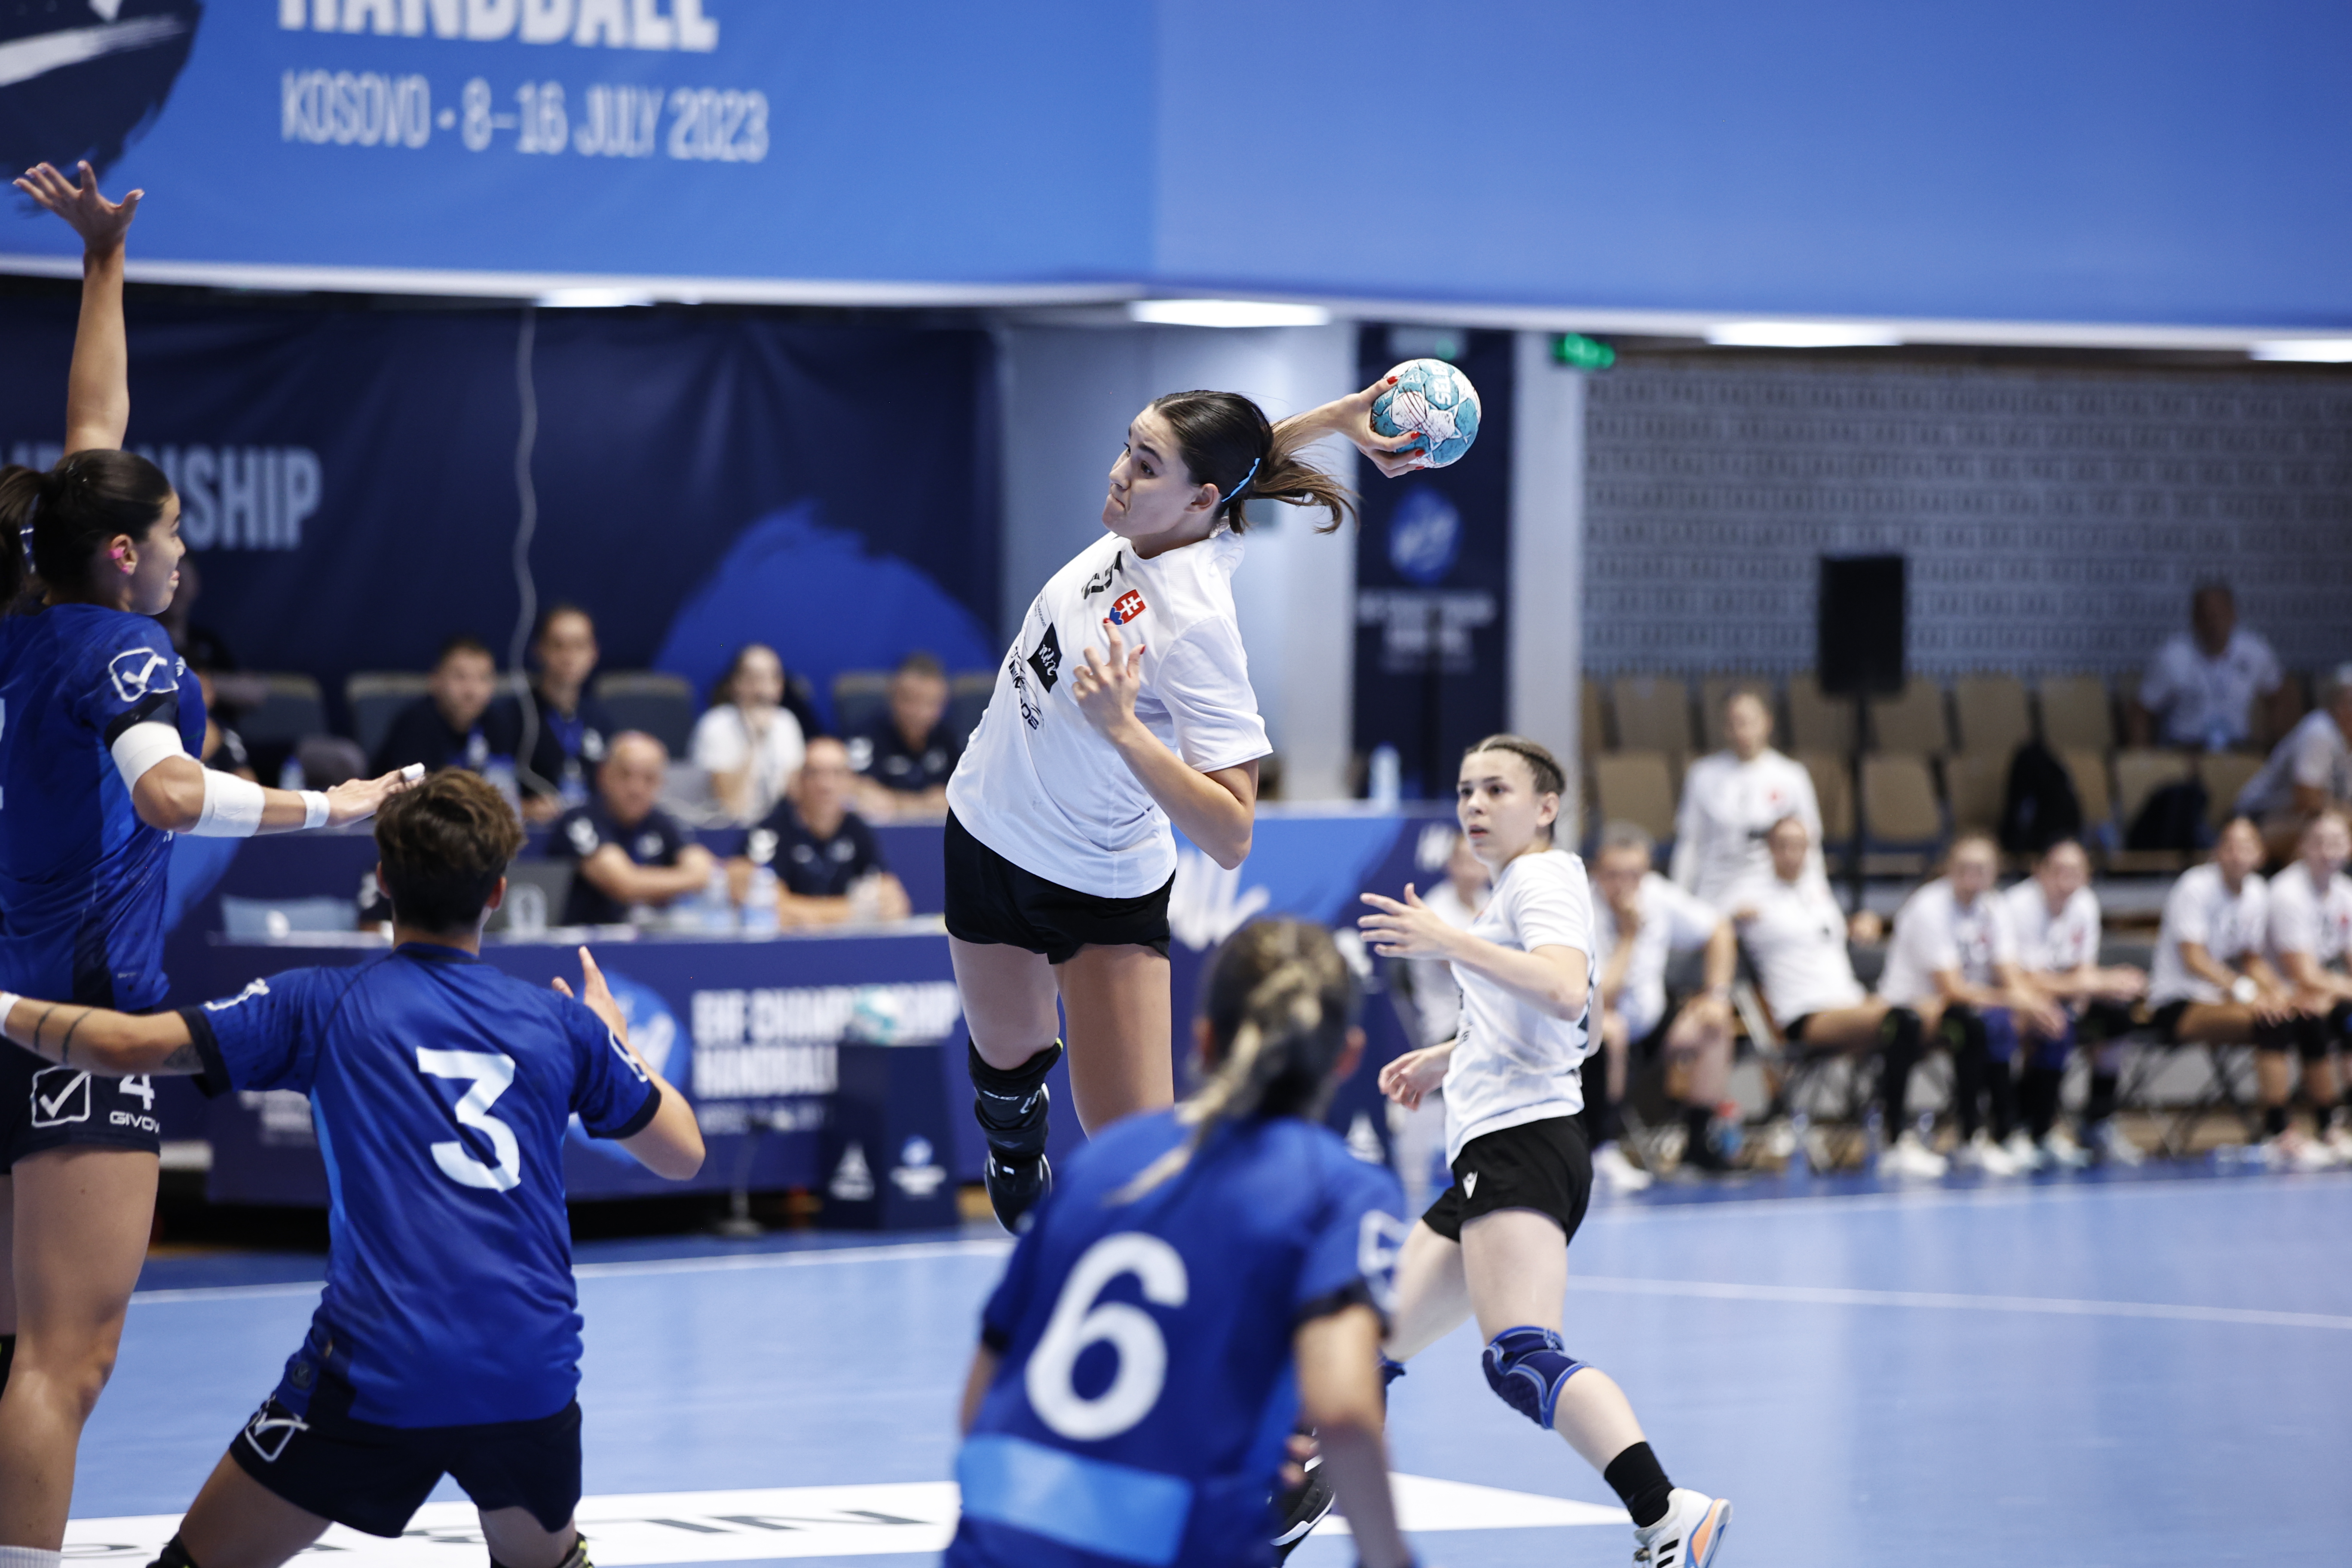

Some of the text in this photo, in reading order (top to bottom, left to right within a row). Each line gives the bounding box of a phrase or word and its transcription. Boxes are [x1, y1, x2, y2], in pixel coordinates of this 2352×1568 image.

[280, 69, 431, 148] KOSOVO
[573, 83, 665, 158] JULY
[667, 88, 769, 163] 2023
[416, 1046, 521, 1193] 3
[1025, 1232, 1189, 1442] 6
